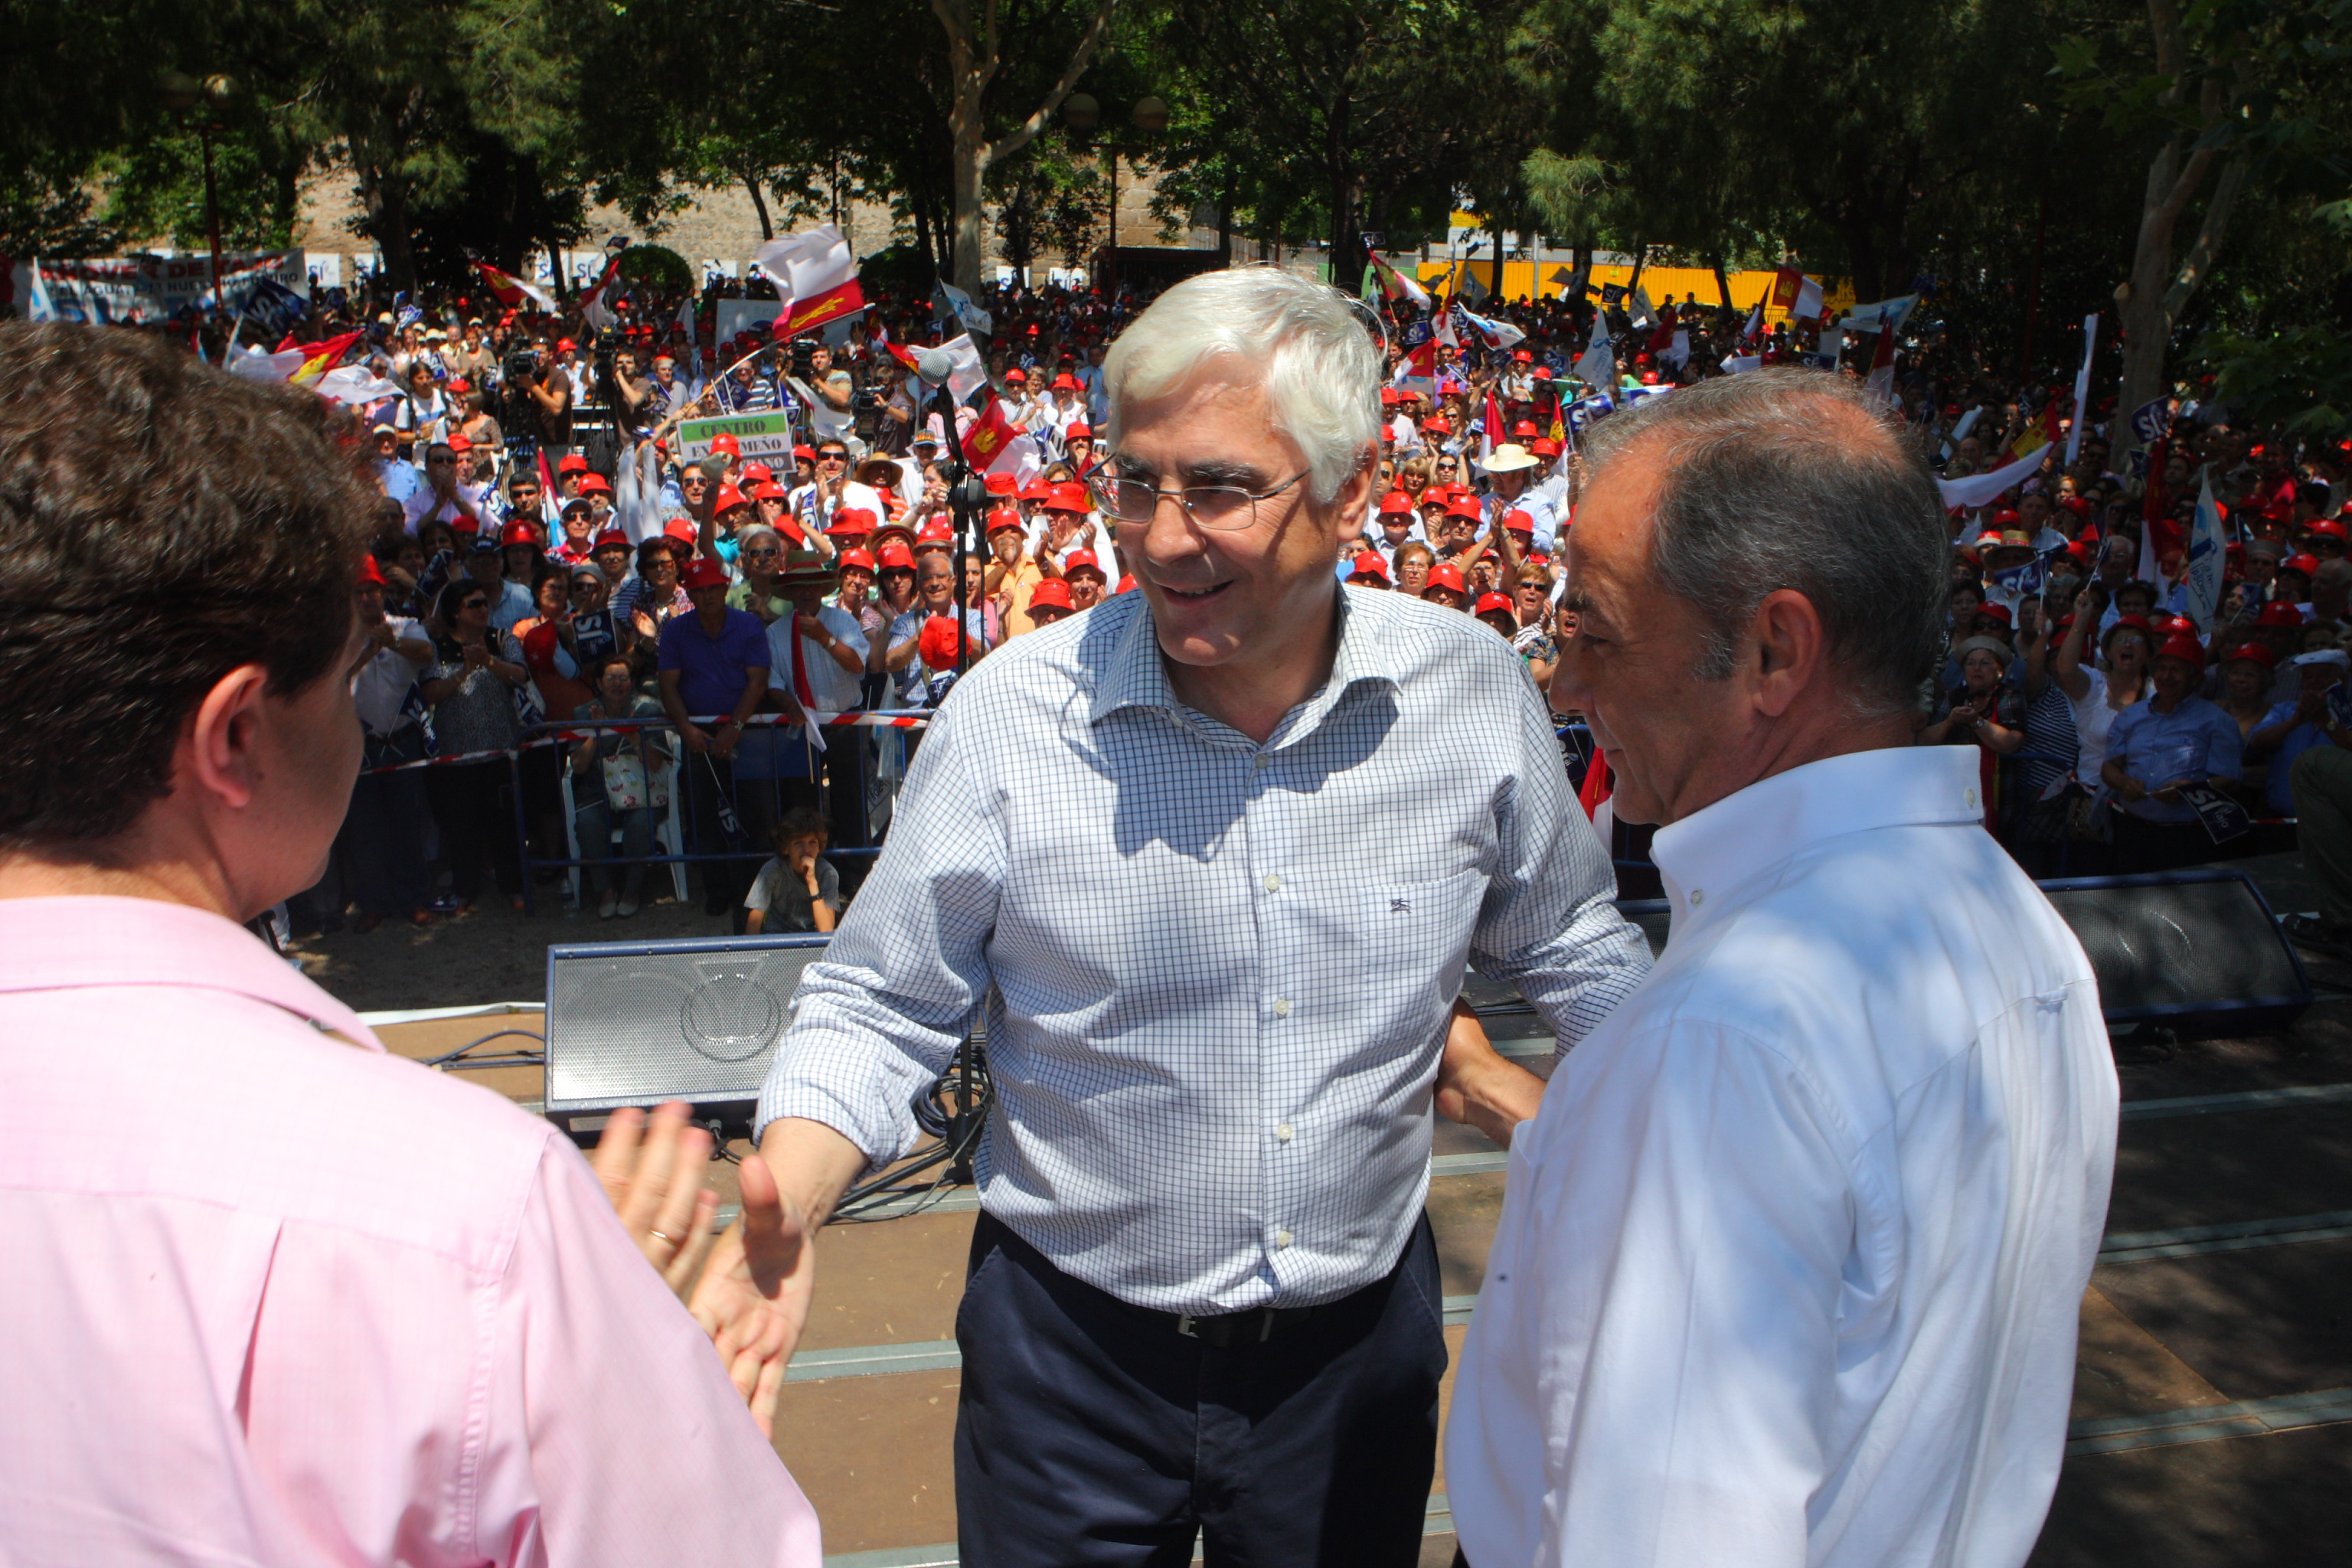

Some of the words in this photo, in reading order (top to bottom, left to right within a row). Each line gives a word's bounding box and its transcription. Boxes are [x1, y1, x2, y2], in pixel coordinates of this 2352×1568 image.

[168, 262, 204, 279] DE
[701, 420, 766, 438] CENTRO
[692, 436, 781, 458] EXMEÑO
